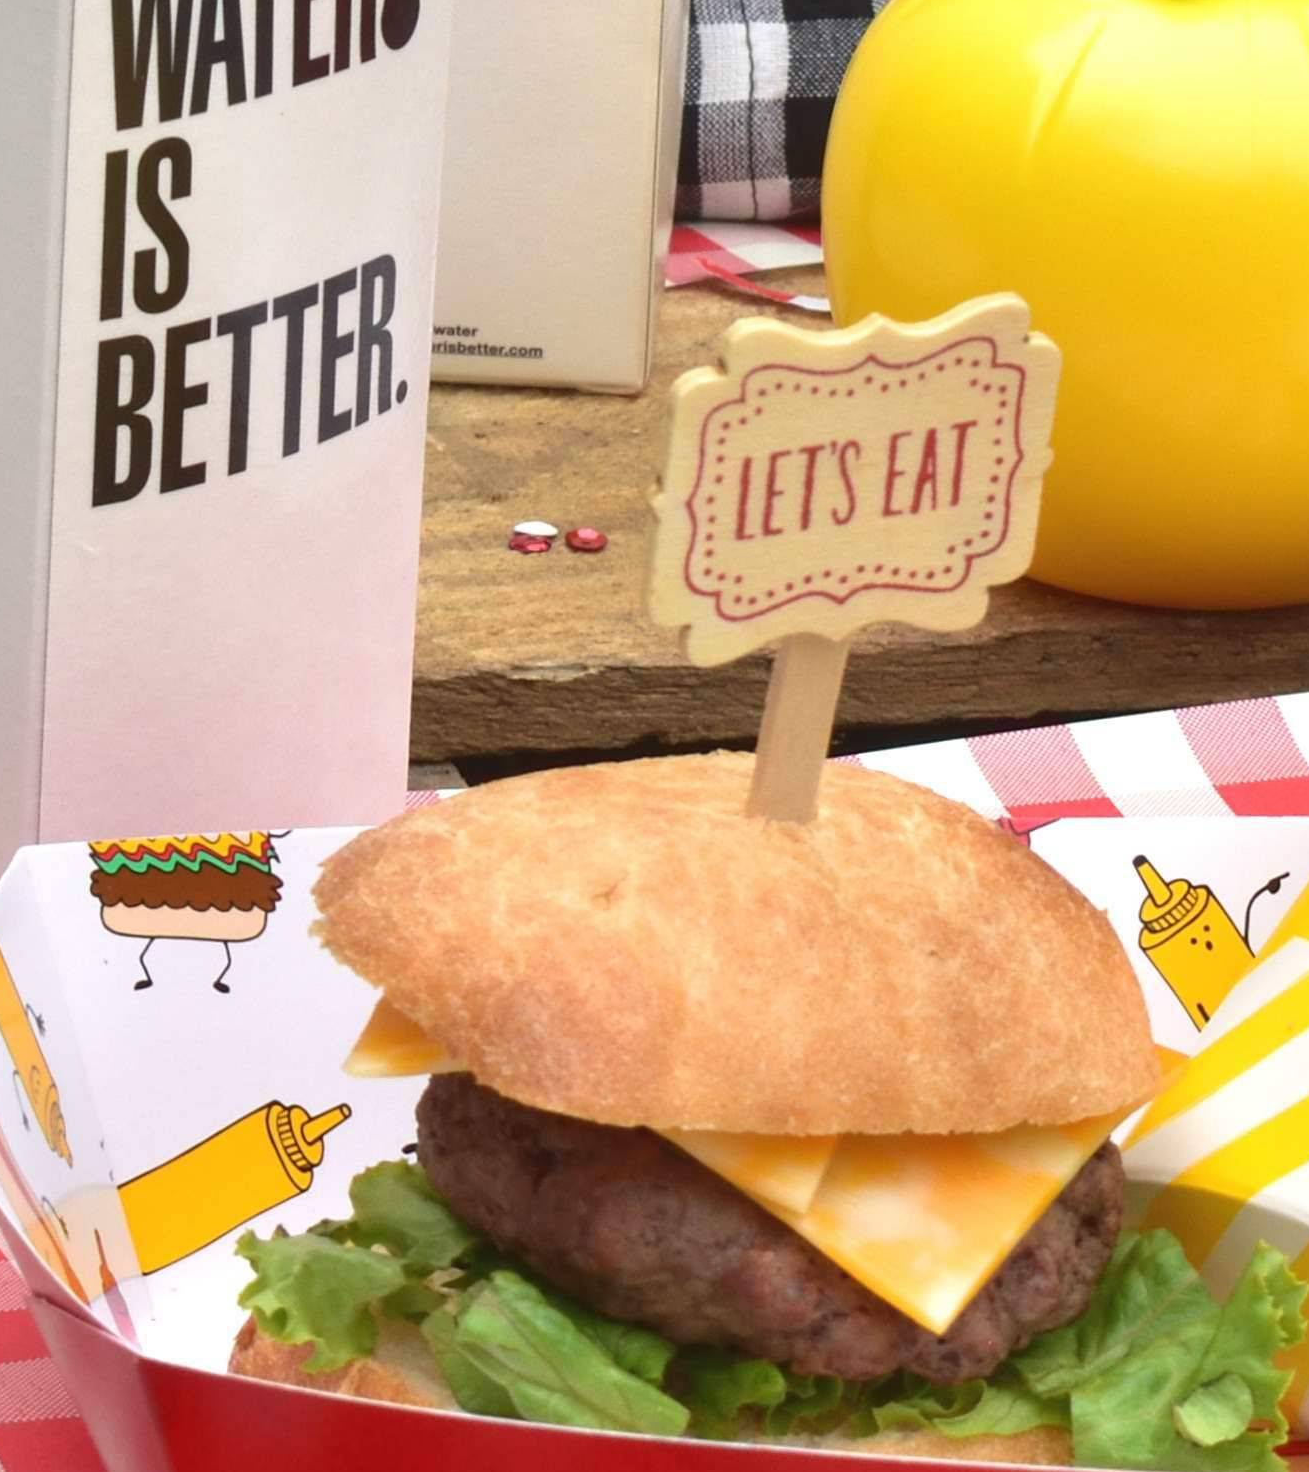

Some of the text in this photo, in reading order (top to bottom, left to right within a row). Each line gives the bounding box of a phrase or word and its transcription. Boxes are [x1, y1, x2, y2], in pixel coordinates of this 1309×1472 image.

[98, 136, 194, 322] IS
[91, 253, 409, 509] BETTER.
[735, 420, 978, 541] LET'S EAT
